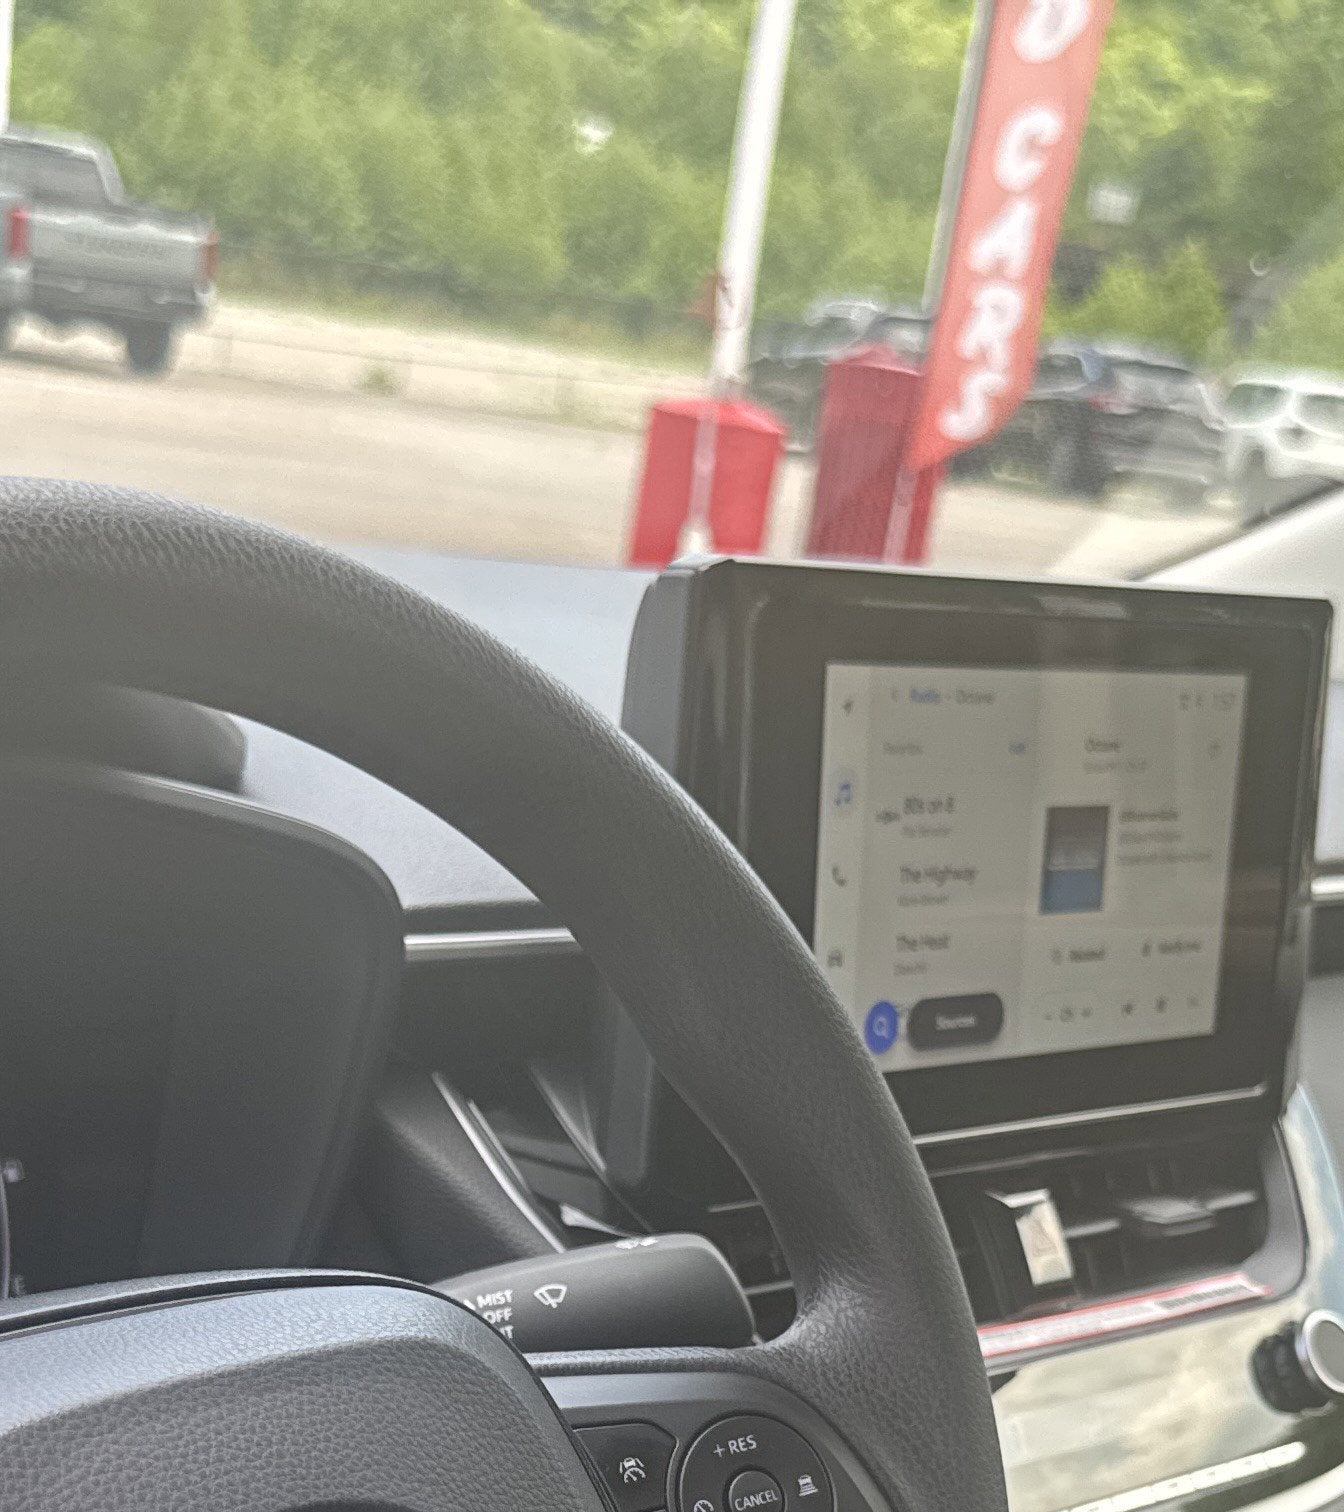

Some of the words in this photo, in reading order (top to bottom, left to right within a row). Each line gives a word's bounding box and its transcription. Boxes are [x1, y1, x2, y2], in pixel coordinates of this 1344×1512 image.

[937, 104, 1065, 440] CARS
[476, 1289, 514, 1309] MIST
[483, 1307, 513, 1325] OFF
[734, 1489, 779, 1512] CANCEL
